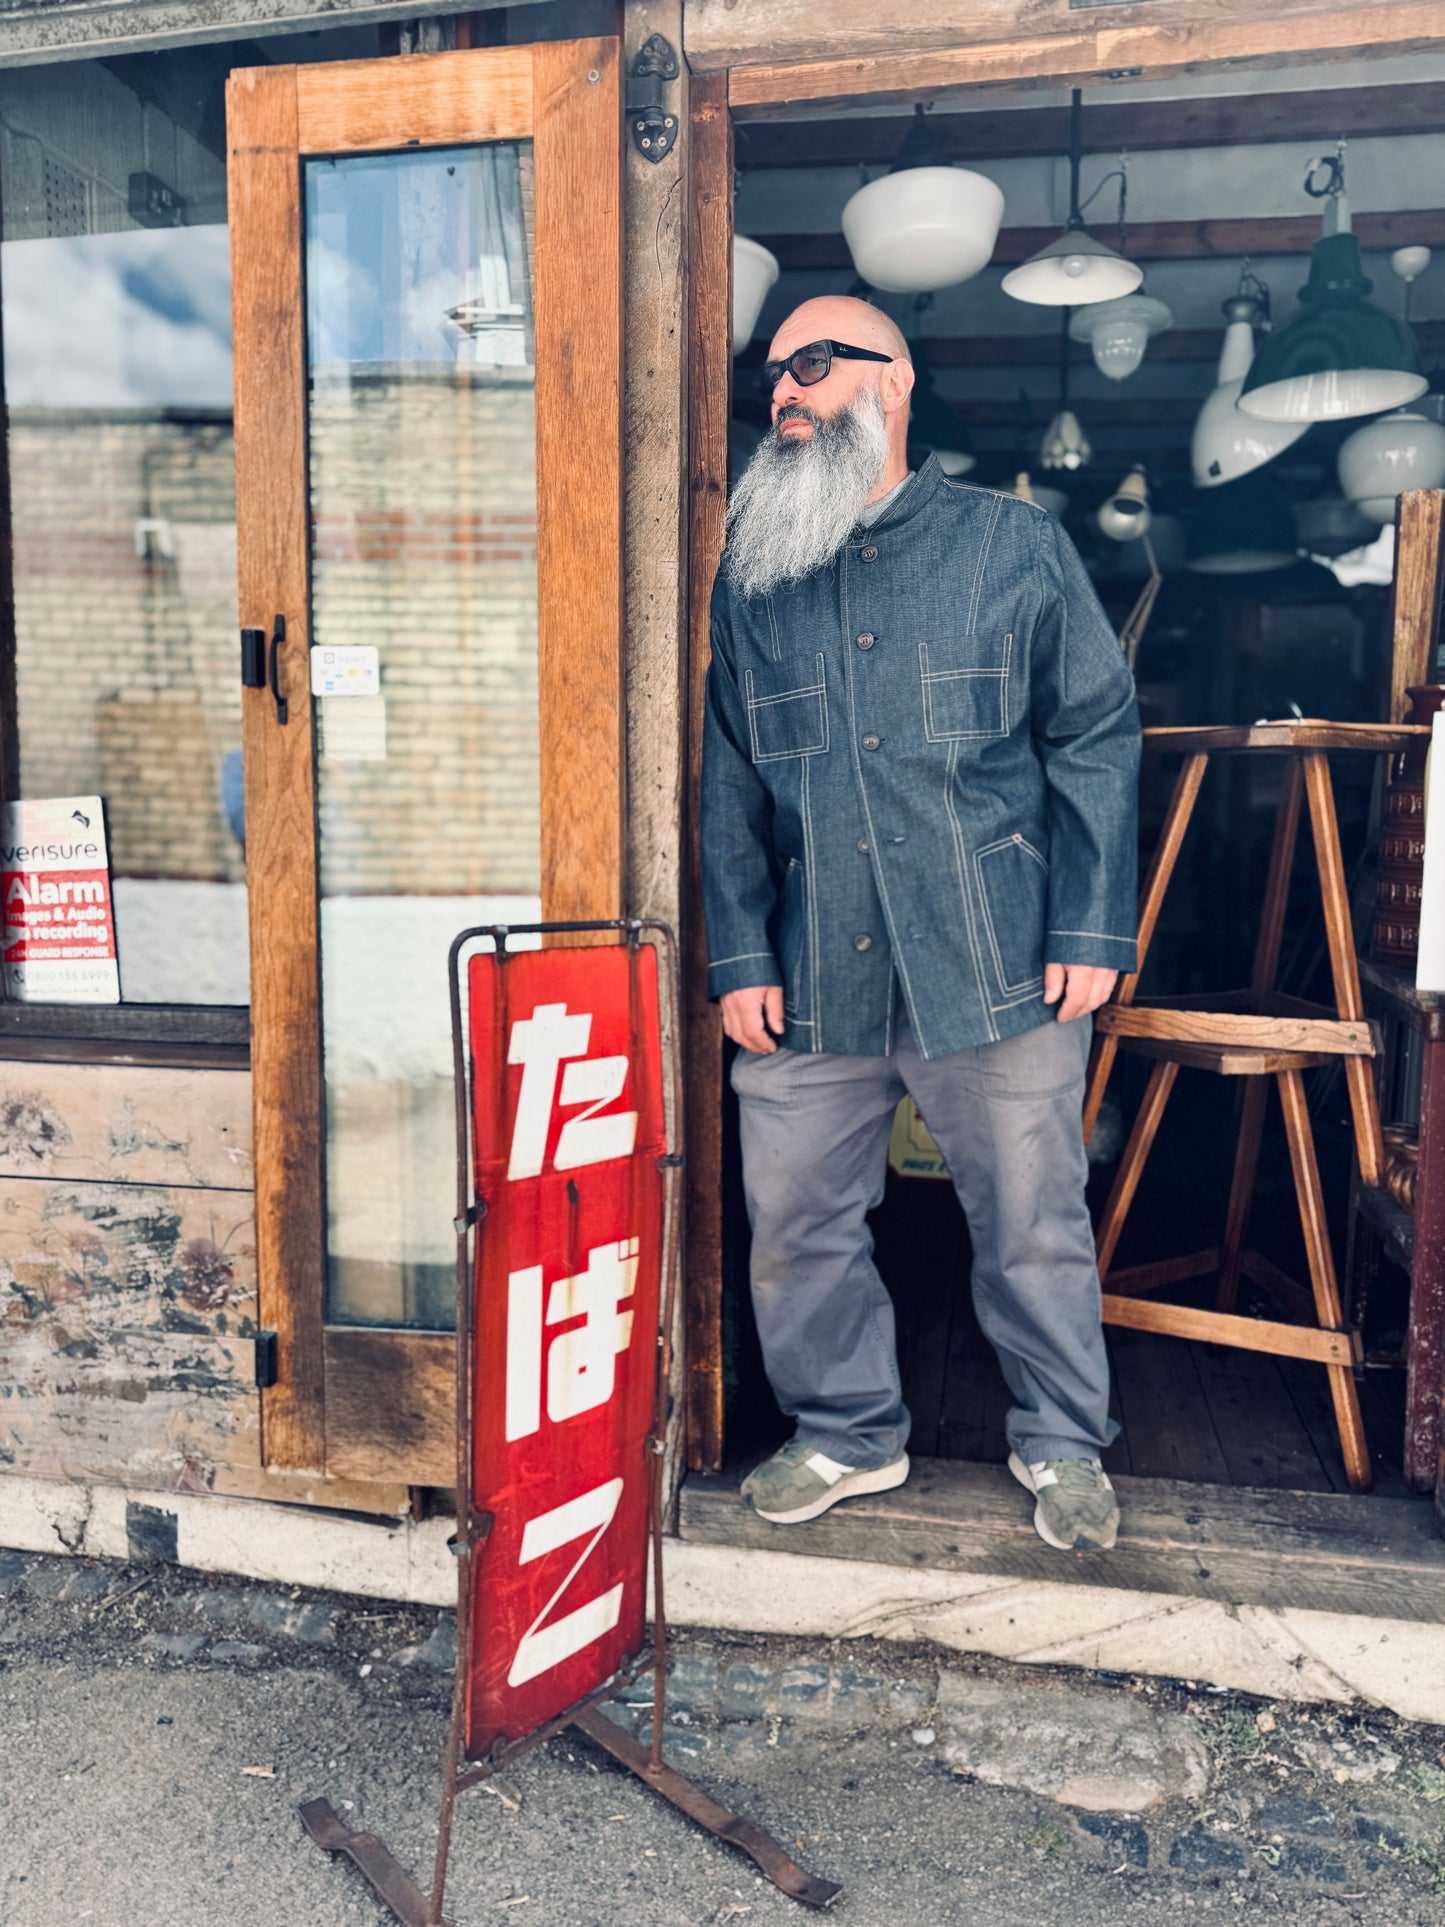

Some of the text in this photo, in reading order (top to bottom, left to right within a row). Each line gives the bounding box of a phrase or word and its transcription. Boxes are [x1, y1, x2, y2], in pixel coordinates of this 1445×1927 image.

[1, 843, 98, 863] verisure
[6, 873, 105, 905] Alarm
[53, 906, 65, 921] &
[66, 905, 107, 921] Audio
[33, 921, 108, 943] recording
[507, 1002, 640, 1687] たばこ
